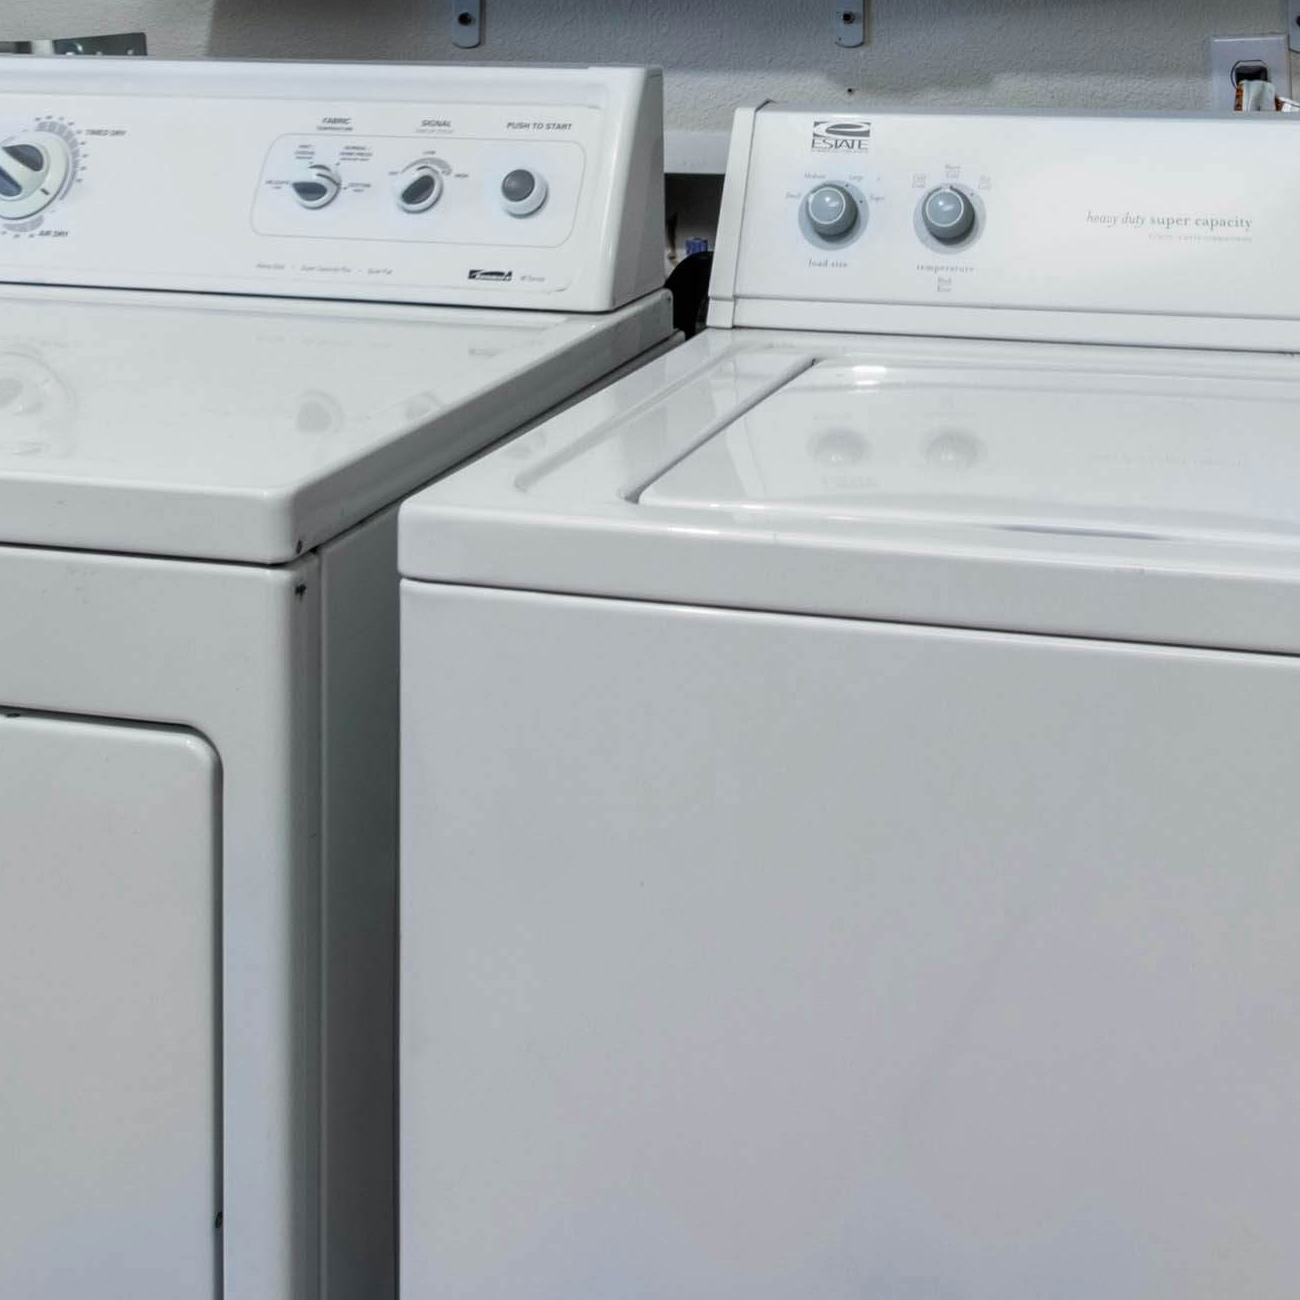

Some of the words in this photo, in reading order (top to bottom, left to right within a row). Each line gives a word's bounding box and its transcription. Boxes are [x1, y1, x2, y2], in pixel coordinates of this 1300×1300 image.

[811, 138, 869, 150] ESTATE
[1086, 211, 1118, 226] heavy
[1121, 211, 1146, 228] duty
[1150, 215, 1190, 230] super
[1195, 214, 1253, 231] capacity
[808, 259, 828, 268] load
[831, 260, 849, 268] size
[916, 263, 974, 274] temperature
